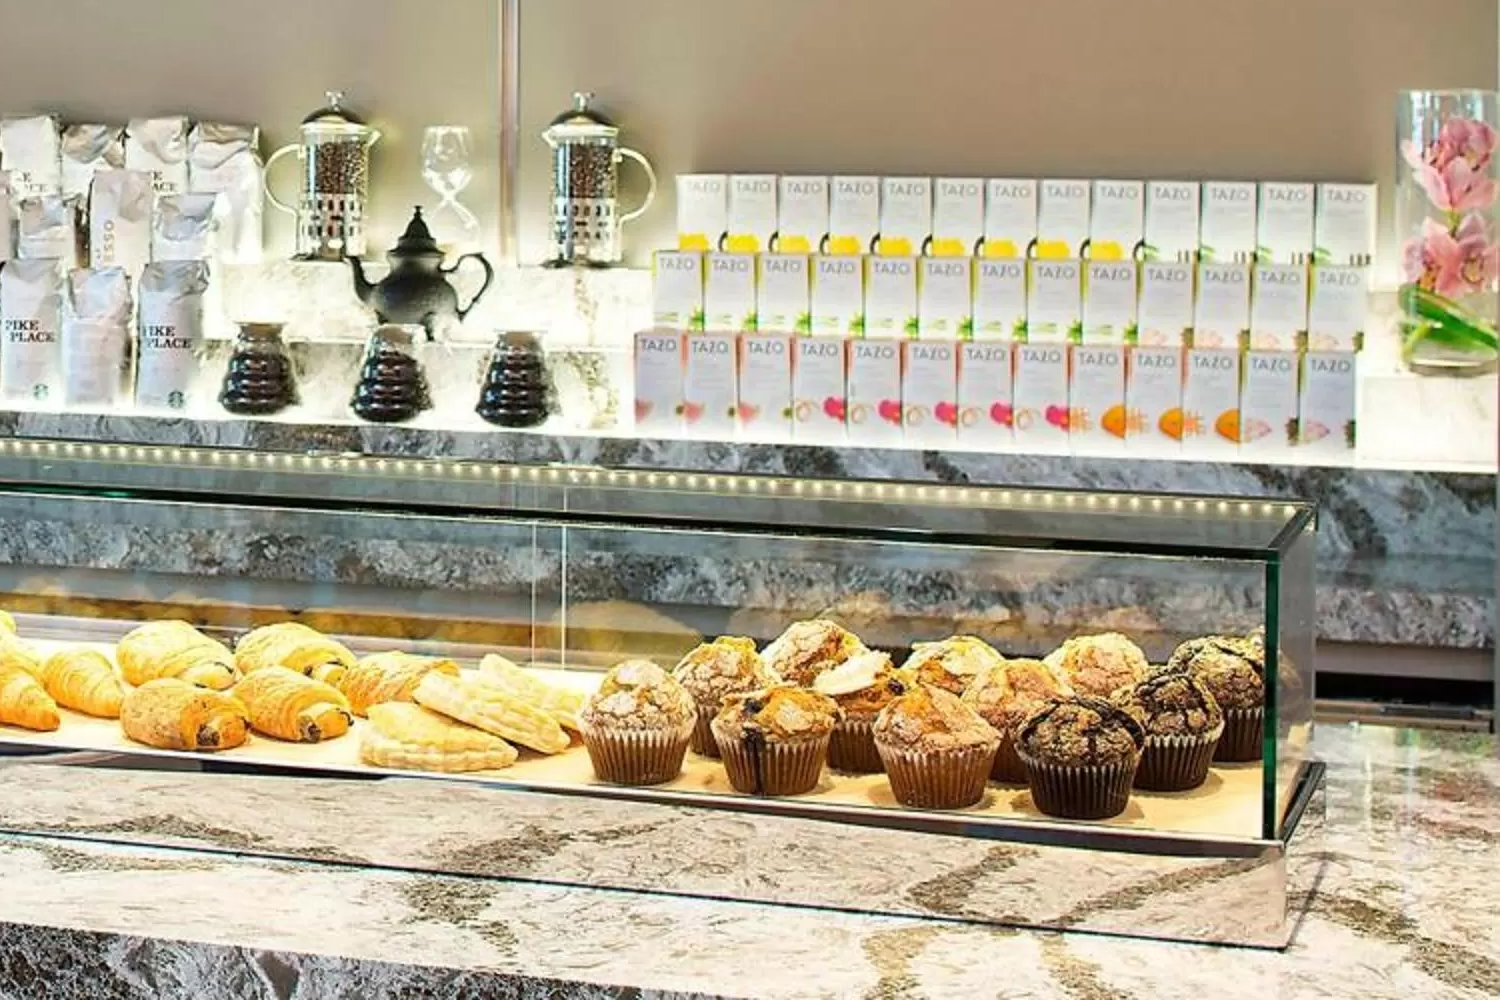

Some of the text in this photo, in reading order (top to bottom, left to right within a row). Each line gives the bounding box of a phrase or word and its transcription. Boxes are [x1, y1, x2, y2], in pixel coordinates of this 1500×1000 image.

[687, 181, 721, 192] TAZO
[736, 181, 770, 193] TAZO
[786, 182, 822, 194] TAZO
[838, 183, 873, 195] TAZO
[887, 184, 924, 196] TAZO
[940, 184, 977, 196] TAZO
[994, 185, 1032, 198] TAZO
[1046, 186, 1084, 198] TAZO
[1100, 186, 1138, 200] TAZO
[1154, 187, 1192, 200] TAZO
[1211, 187, 1249, 200] TAZO
[1268, 188, 1307, 200] TAZO
[1327, 189, 1366, 202] TAZO
[659, 257, 694, 270] TAZO
[712, 258, 748, 271] TAZO
[766, 260, 800, 273] TAZO
[819, 261, 856, 274] TAZO
[874, 262, 910, 275] TAZO
[927, 263, 964, 276] TAZO
[981, 264, 1020, 278] TAZO
[1036, 266, 1075, 280] TAZO
[1092, 267, 1131, 282] TAZO
[1148, 268, 1187, 282] TAZO
[1204, 269, 1243, 283] TAZO
[1261, 270, 1300, 284] TAZO
[1319, 271, 1360, 285] TAZO
[5, 319, 40, 331] PIKE
[10, 331, 56, 343] PLACE
[146, 336, 194, 349] PLACE
[640, 338, 677, 352] TAZO
[690, 340, 729, 354] TAZO
[747, 340, 784, 355] TAZO
[801, 342, 839, 356] TAZO
[856, 345, 895, 358] TAZO
[912, 346, 950, 360] TAZO
[967, 348, 1006, 361] TAZO
[1024, 349, 1062, 363] TAZO
[1079, 351, 1118, 366] TAZO
[1138, 352, 1176, 368] TAZO
[1194, 354, 1234, 370] TAZO
[1251, 355, 1291, 371] TAZO
[1310, 356, 1350, 372] TAZO
